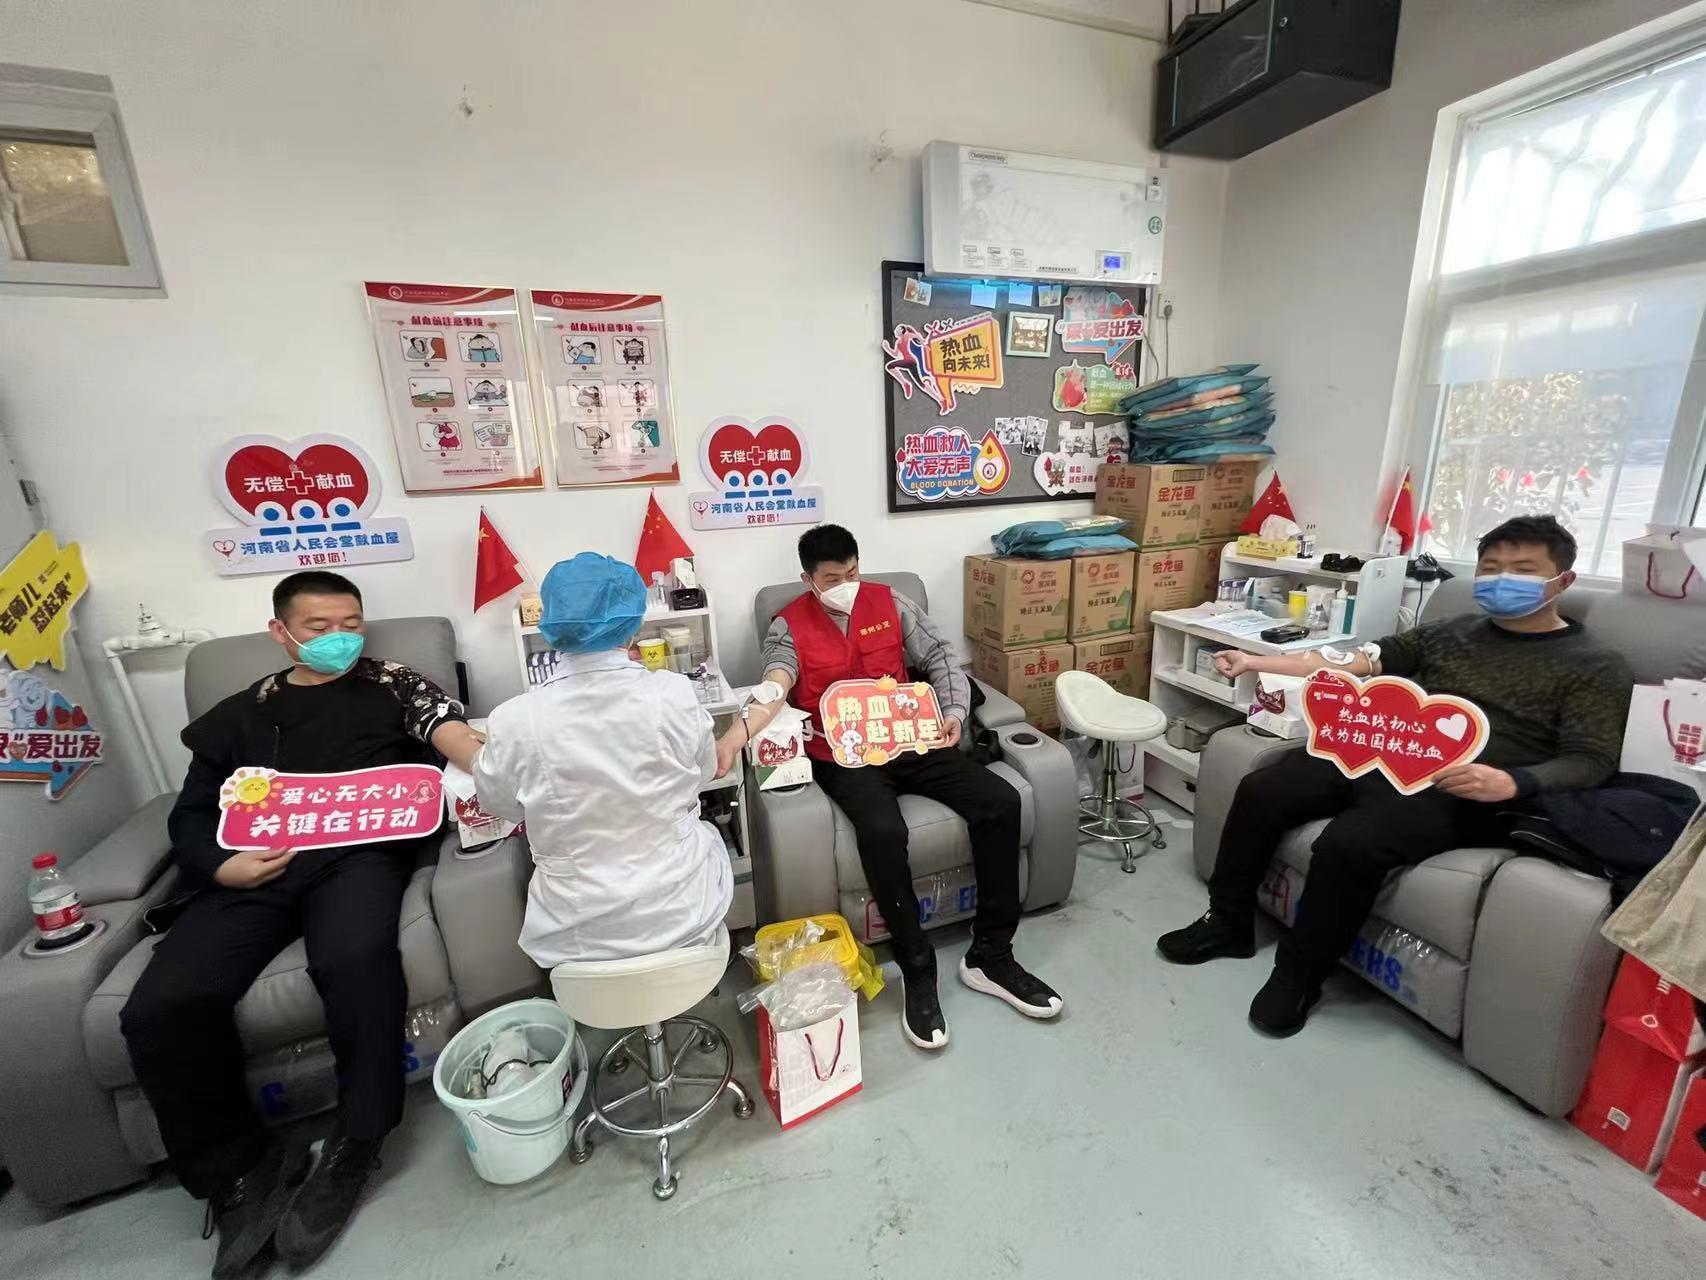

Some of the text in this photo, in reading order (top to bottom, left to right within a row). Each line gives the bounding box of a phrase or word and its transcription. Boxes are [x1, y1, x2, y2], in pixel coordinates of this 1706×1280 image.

[940, 334, 982, 358] 热血
[943, 354, 990, 373] 向未来!
[906, 434, 971, 454] 热血救人
[720, 449, 792, 463] 无偿 献血
[906, 456, 971, 476] 大爱无声
[244, 473, 354, 493] 无偿 献血
[911, 479, 974, 489] BLOOD DONATION
[1107, 475, 1136, 488] 金龙鱼
[1157, 485, 1197, 502] 金龙鱼
[241, 532, 400, 555] 河南省人民会堂献血屋
[1152, 560, 1184, 574] 金龙鱼
[1024, 659, 1060, 676] 金龙鱼
[1086, 657, 1127, 675] 金龙鱼
[837, 696, 892, 724] 热血
[280, 783, 409, 806] 爱心无大小
[250, 805, 420, 838] 关键在行动
